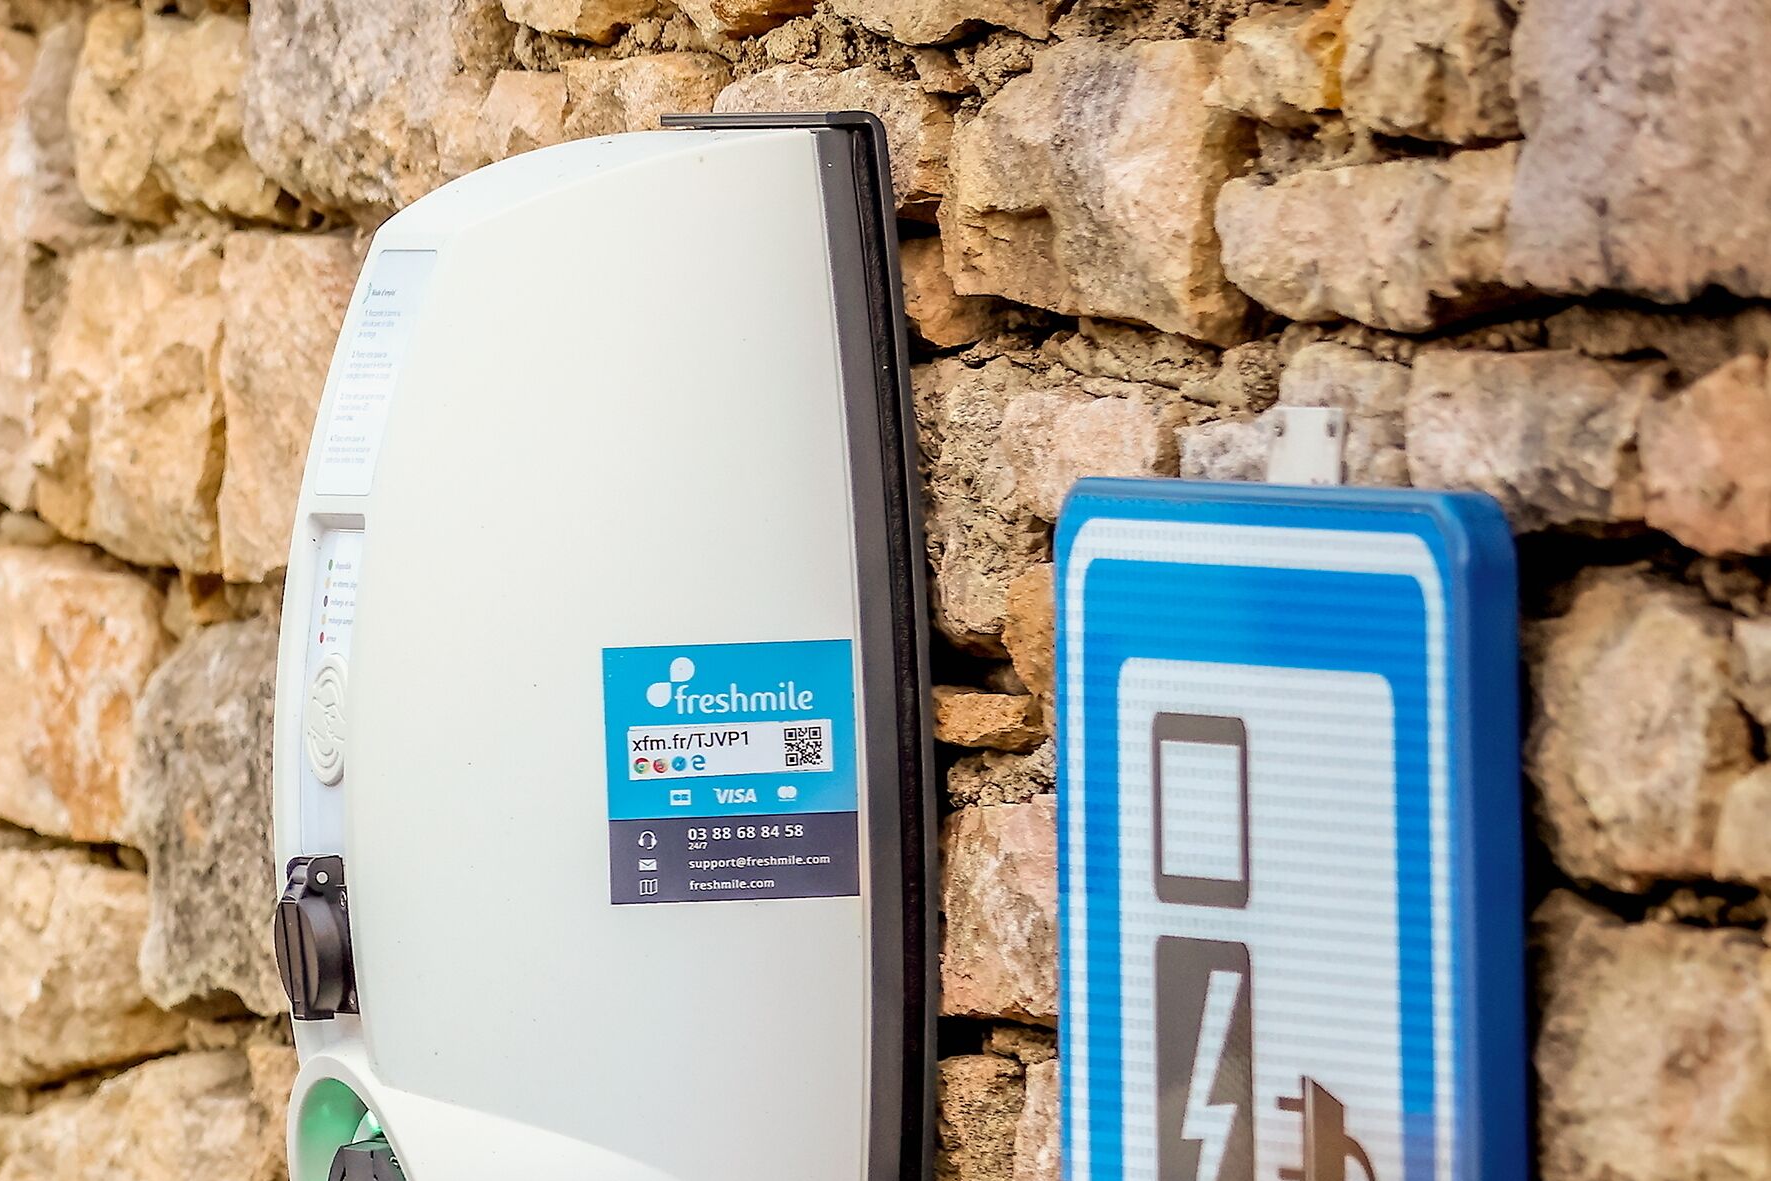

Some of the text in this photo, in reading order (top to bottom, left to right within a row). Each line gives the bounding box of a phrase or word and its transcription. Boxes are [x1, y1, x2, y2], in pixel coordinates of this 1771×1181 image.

[674, 680, 814, 715] freshmile
[632, 730, 749, 752] xfm.fr/TJVP1
[713, 788, 758, 804] VISA
[688, 824, 804, 841] 03 88 68 84 58
[688, 841, 708, 850] 24/7
[688, 854, 830, 871] support@freshmile.com
[689, 877, 775, 891] freshmile.com
